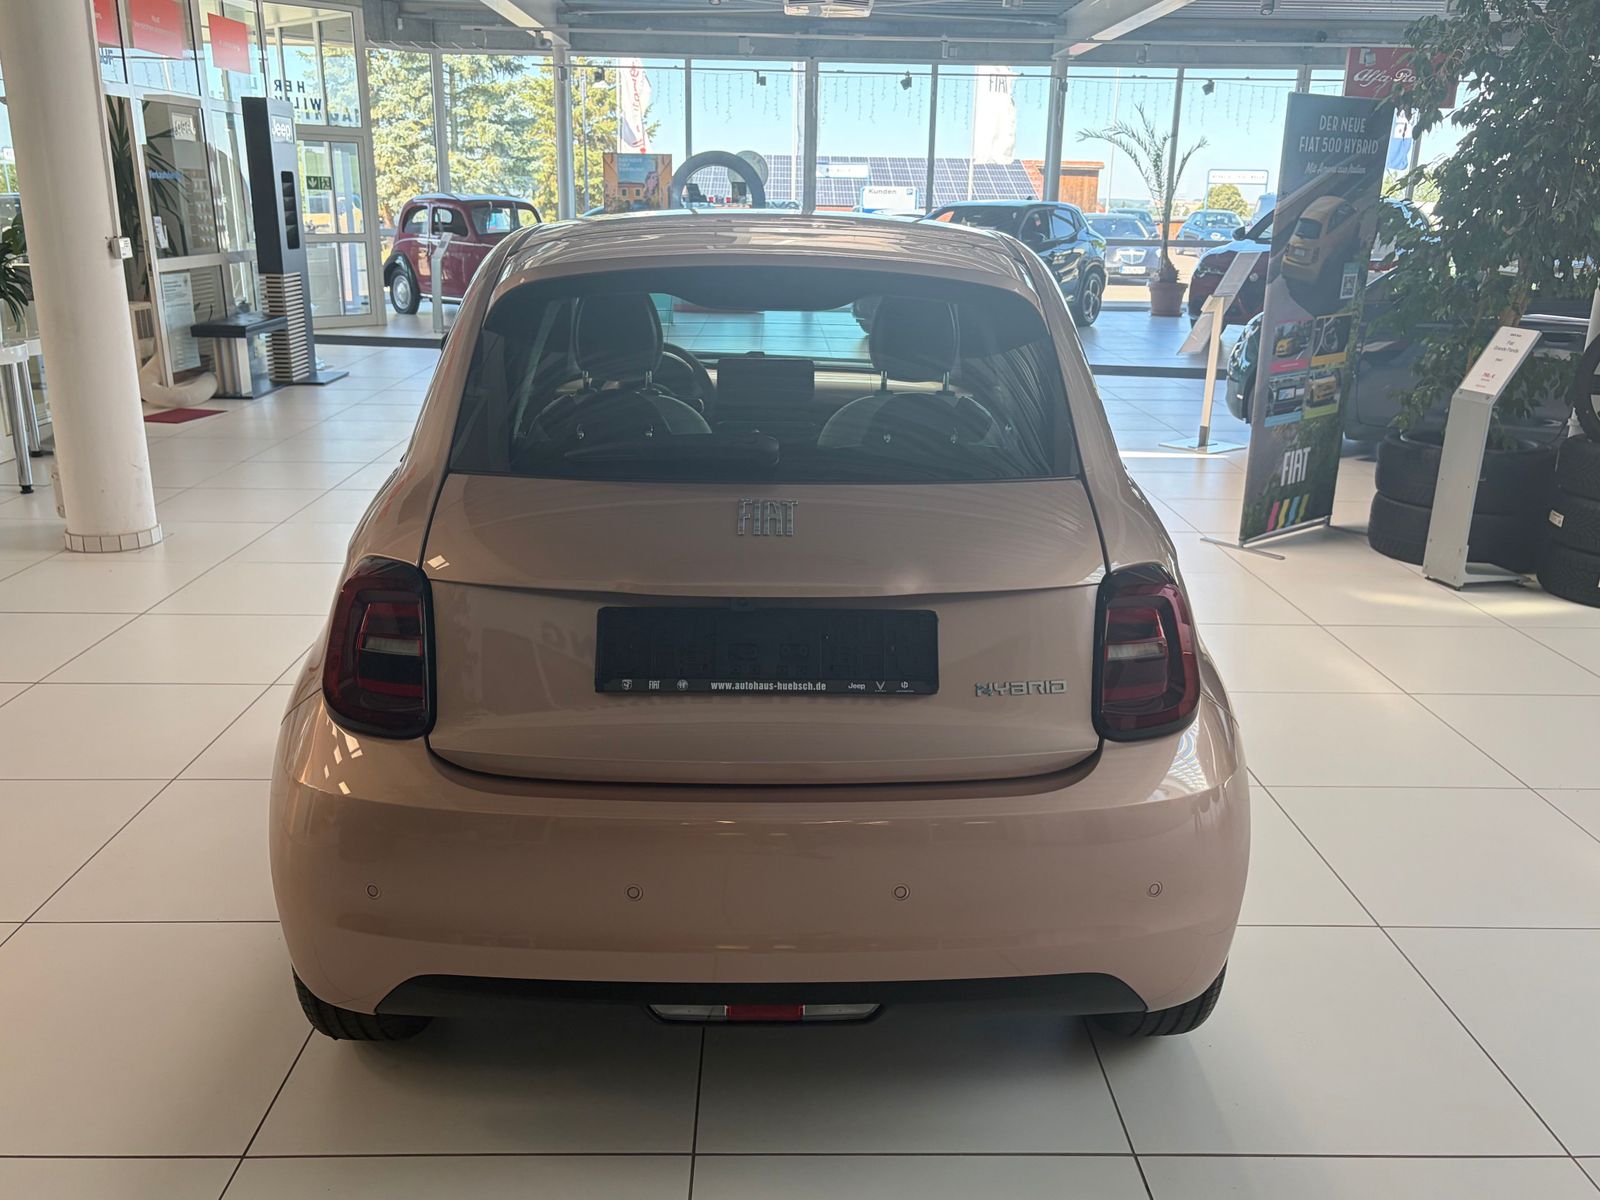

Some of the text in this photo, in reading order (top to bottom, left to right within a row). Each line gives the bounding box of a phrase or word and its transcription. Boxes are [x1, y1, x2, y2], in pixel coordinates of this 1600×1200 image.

[271, 119, 293, 141] Jeep
[1319, 114, 1367, 133] DER NEUE
[1298, 136, 1379, 155] FIAT 500 HYBRID
[868, 187, 897, 195] Kunden
[1281, 447, 1311, 486] FIAT
[736, 498, 799, 536] FIAT
[710, 681, 827, 691] www.autohaus-huebsch.de
[848, 682, 866, 691] Jeep
[975, 679, 1068, 697] HYBRID
